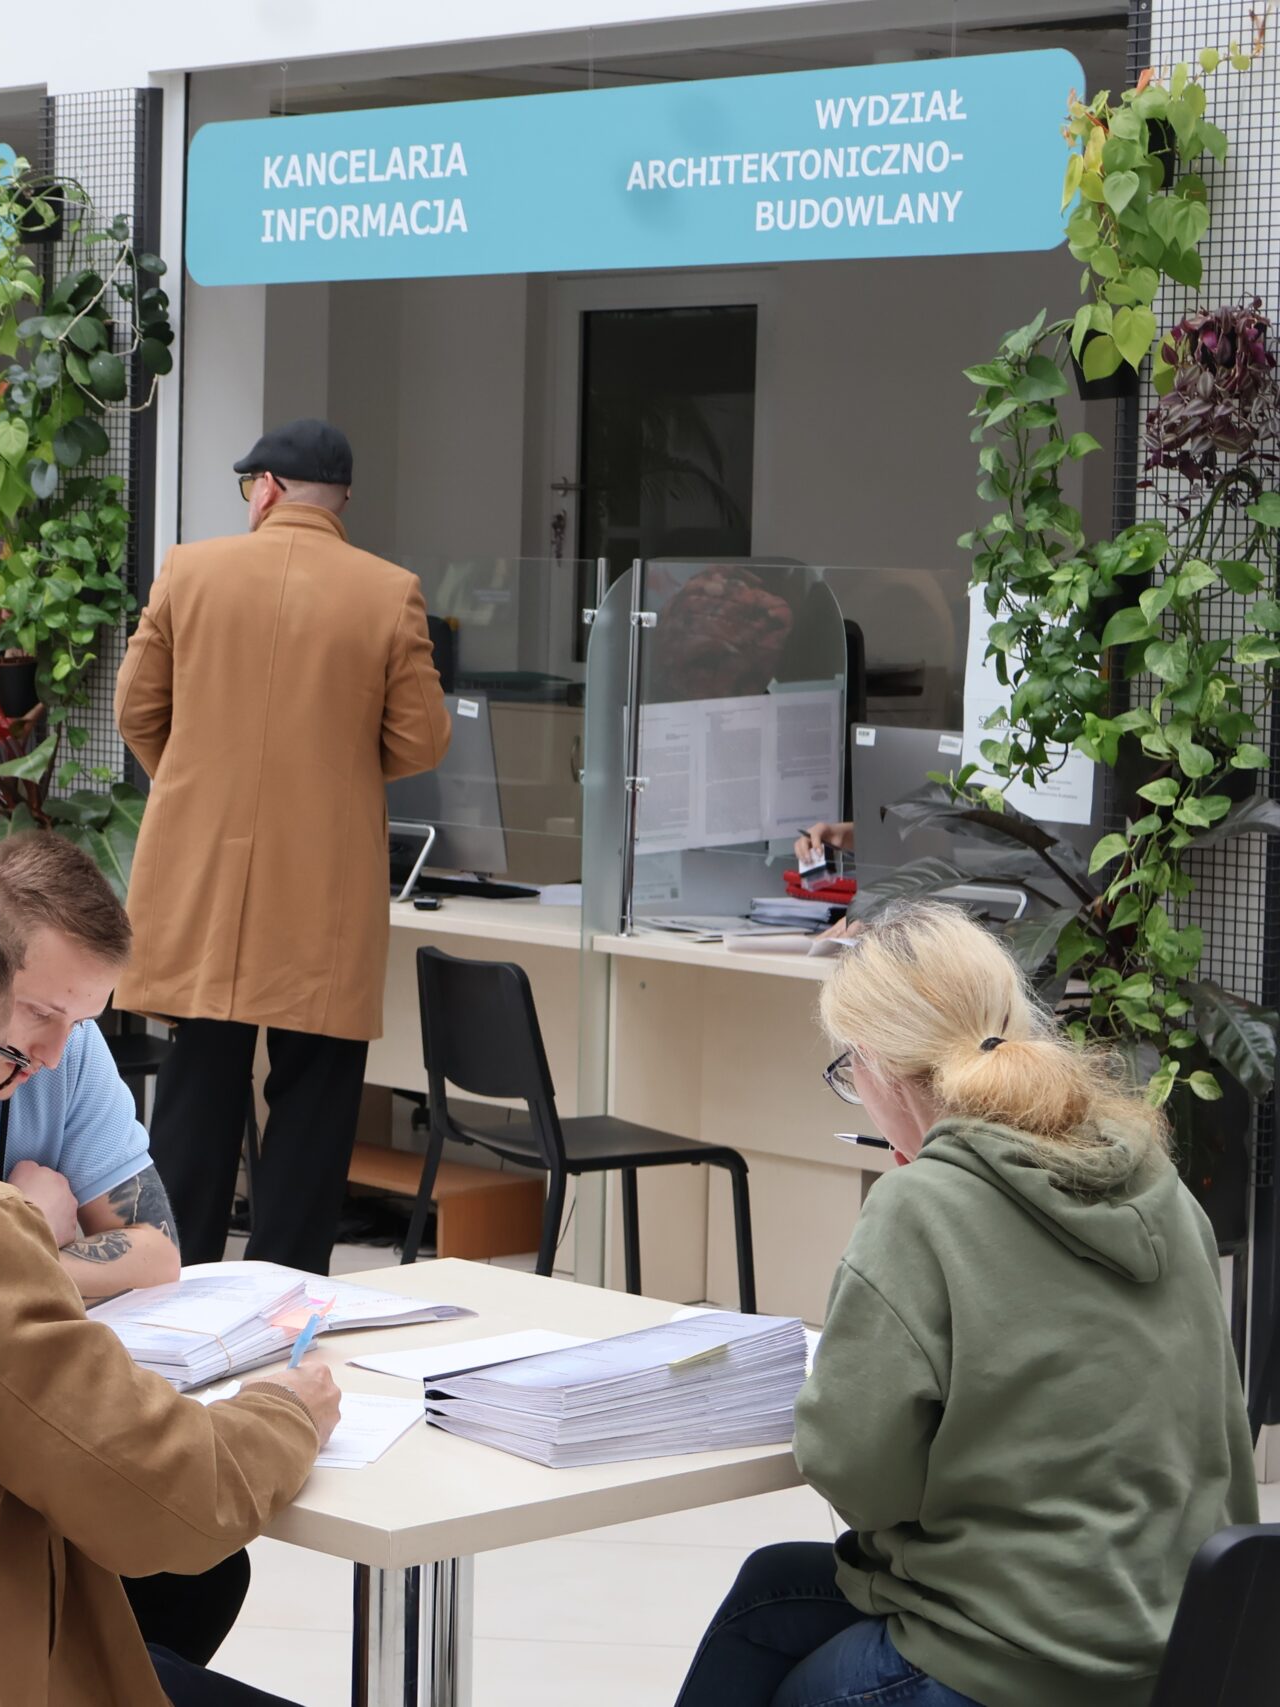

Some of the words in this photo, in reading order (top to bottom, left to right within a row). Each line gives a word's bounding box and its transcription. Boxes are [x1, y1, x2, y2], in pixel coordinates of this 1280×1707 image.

[816, 88, 967, 130] WYDZIAŁ
[263, 142, 468, 189] KANCELARIA
[626, 141, 964, 191] ARCHITEKTONICZNO-
[260, 199, 468, 243] INFORMACJA
[755, 190, 963, 232] BUDOWLANY
